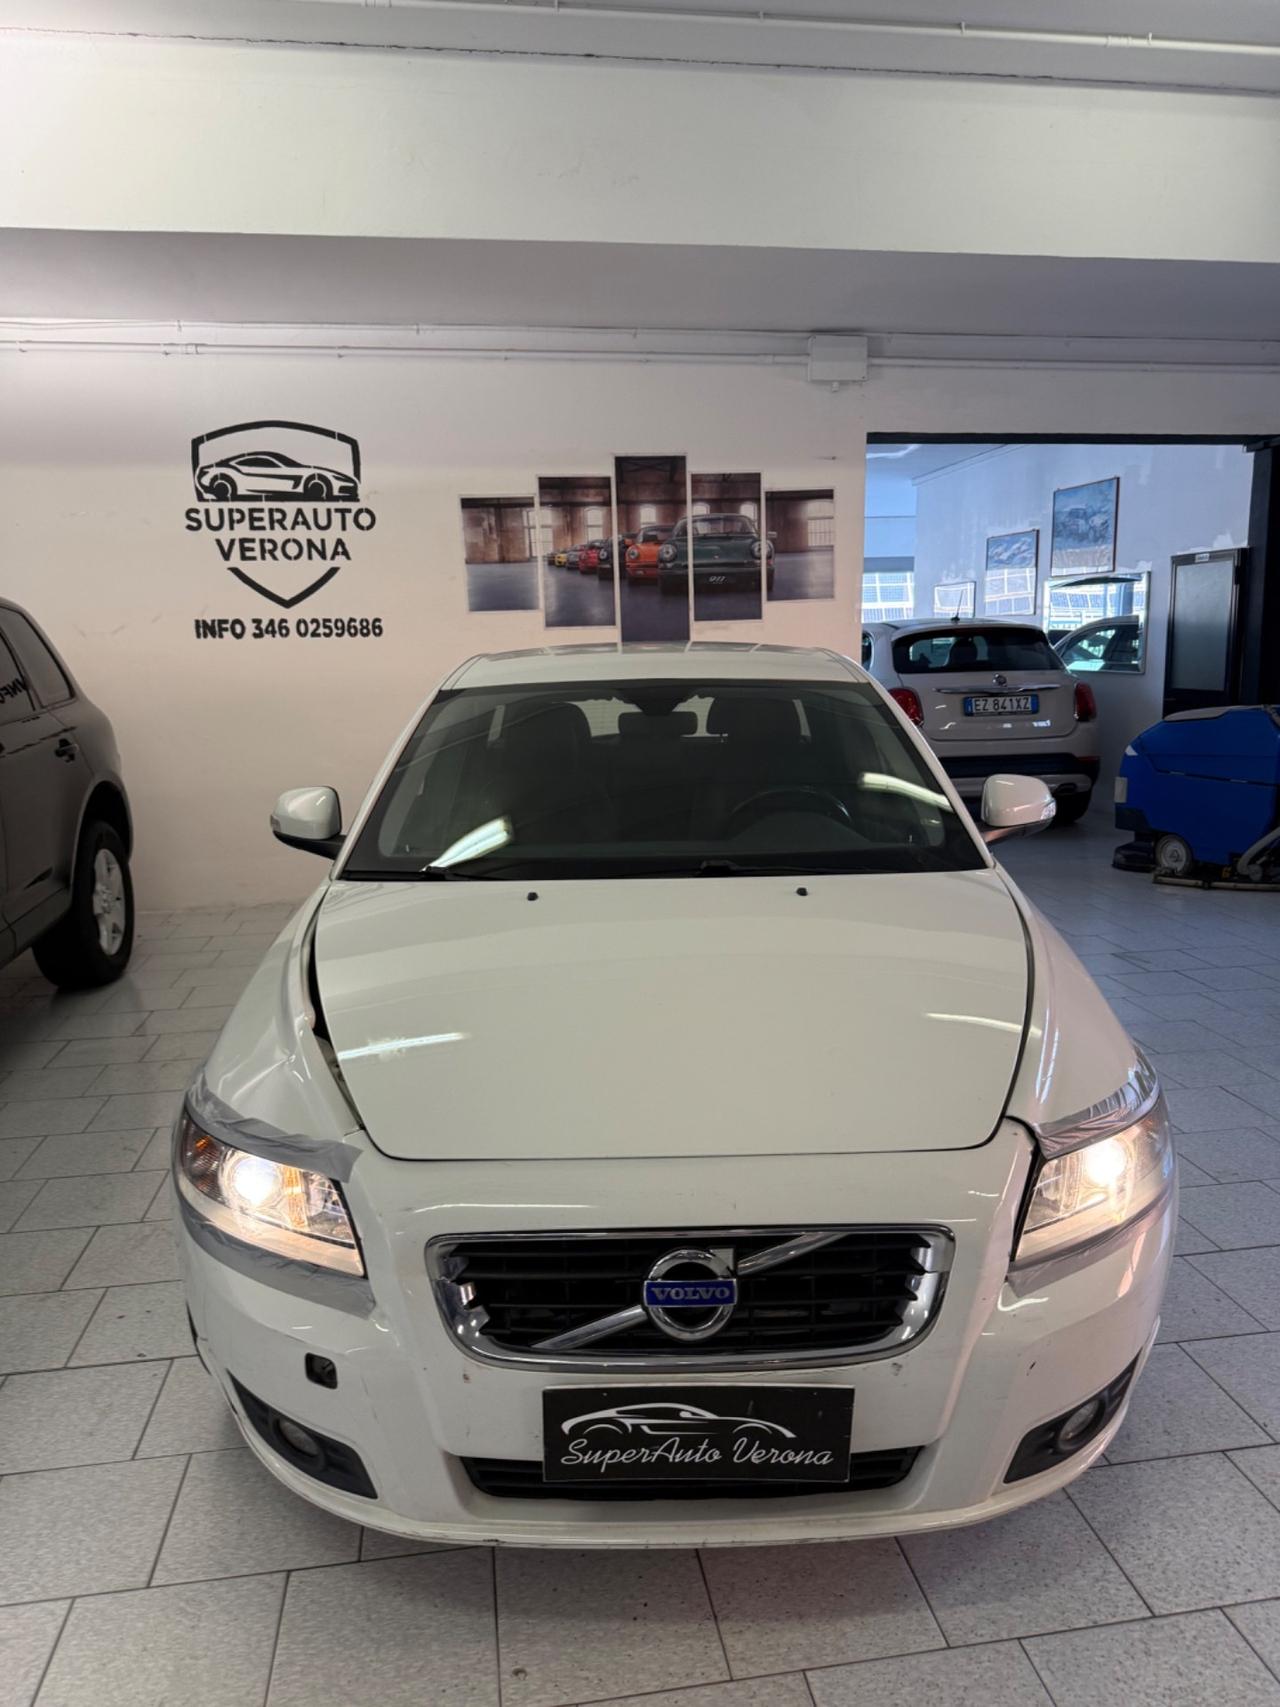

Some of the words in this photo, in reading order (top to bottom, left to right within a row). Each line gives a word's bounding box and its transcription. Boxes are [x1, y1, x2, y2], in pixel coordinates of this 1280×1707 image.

[185, 508, 376, 531] SUPERAUTO
[215, 538, 351, 561] VERONA
[194, 618, 246, 640] INFO
[251, 618, 290, 638] 346
[296, 617, 383, 638] 0259686
[974, 699, 989, 711] EZ
[992, 697, 1030, 711] 841XZ
[651, 1286, 731, 1301] VOLVO
[560, 1437, 722, 1473] SuperAuto
[732, 1437, 834, 1465] Verona
